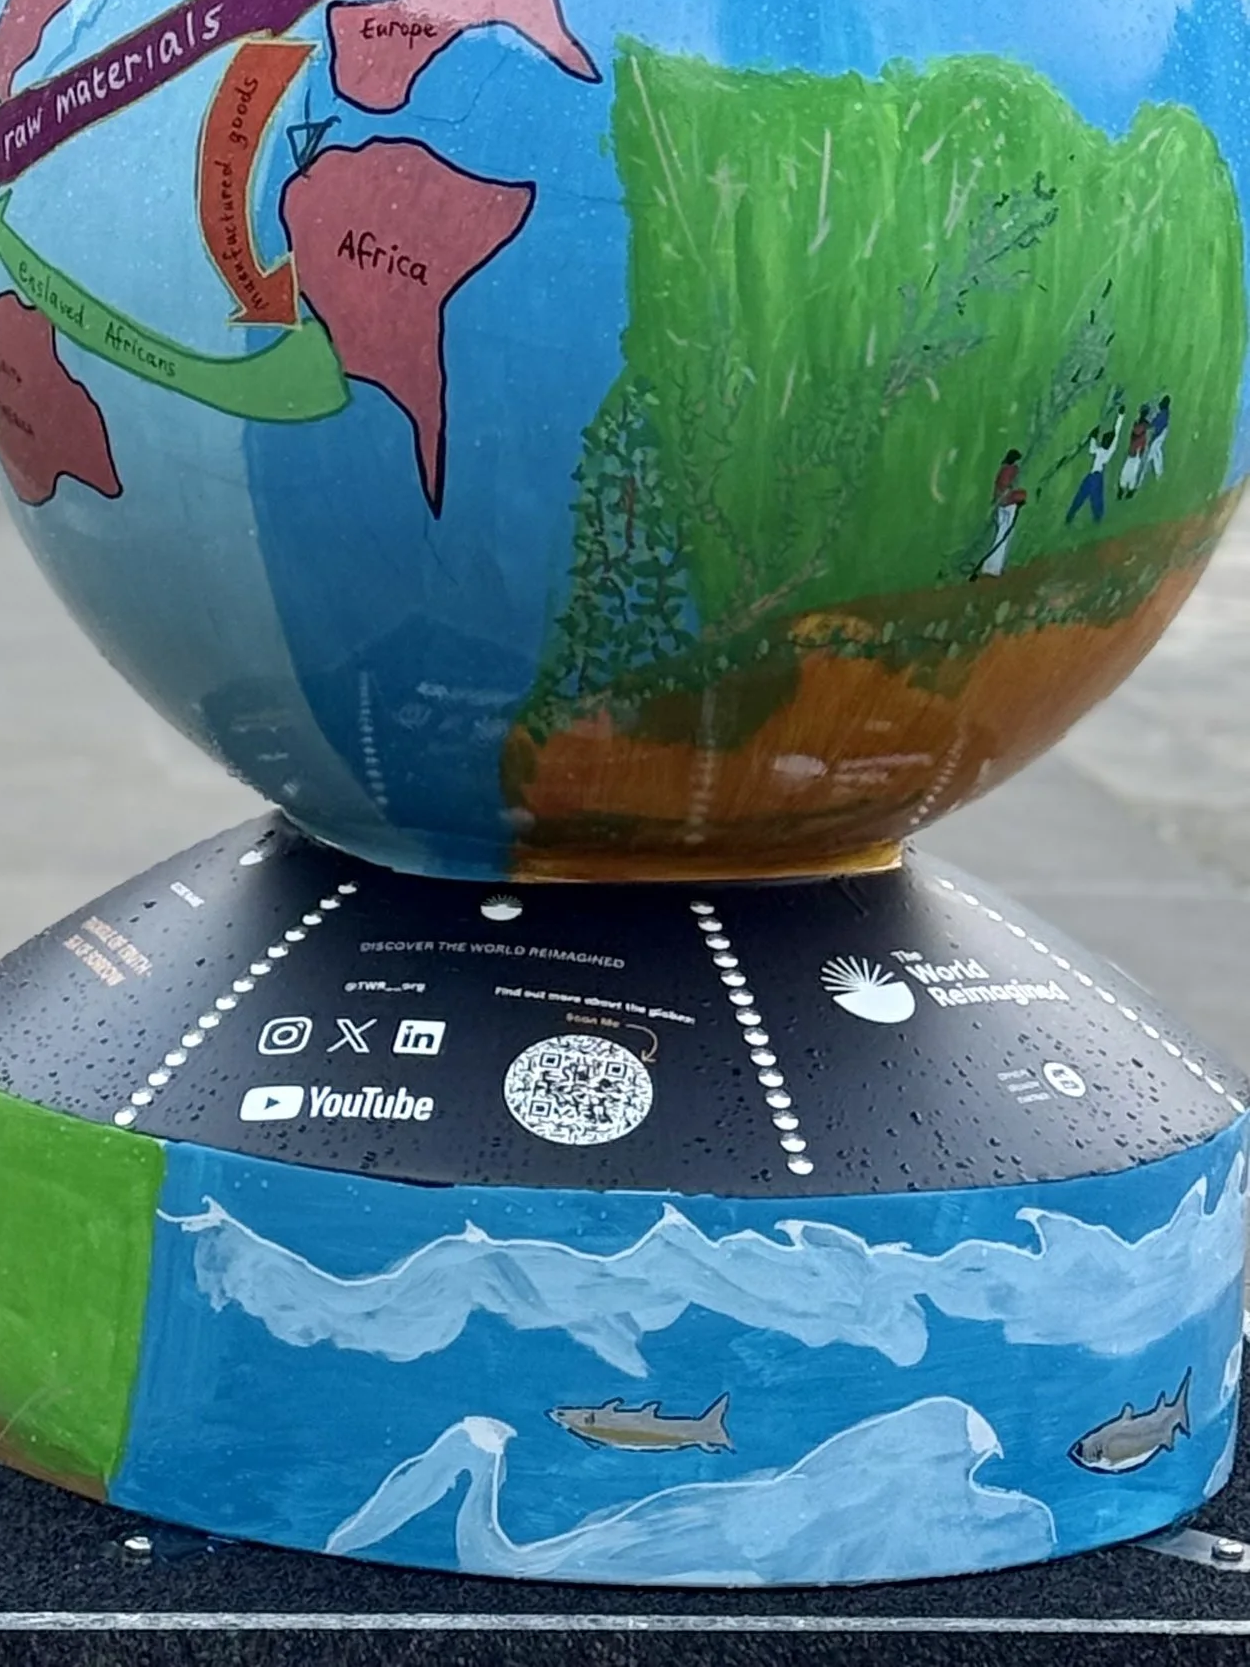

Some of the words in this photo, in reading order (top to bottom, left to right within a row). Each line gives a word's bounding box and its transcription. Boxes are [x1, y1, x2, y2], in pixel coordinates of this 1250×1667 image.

[359, 17, 438, 49] Europe
[4, 106, 43, 161] raw
[57, 3, 224, 123] materials
[229, 76, 258, 150] goods
[337, 229, 428, 286] Africa
[19, 261, 85, 328] enslaved
[105, 321, 176, 377] Africans
[360, 941, 434, 953] DISCOVER
[438, 941, 467, 953] THE
[470, 942, 525, 956] WORLD
[528, 947, 625, 969] REIMAGINED
[890, 950, 923, 963] The
[905, 958, 990, 984] World
[495, 986, 522, 998] Find
[524, 990, 546, 1000] out
[548, 993, 581, 1003] more
[584, 997, 622, 1010] about
[625, 1003, 646, 1014] the
[927, 979, 1070, 1007] Reimagined
[309, 1086, 434, 1121] YouTube
